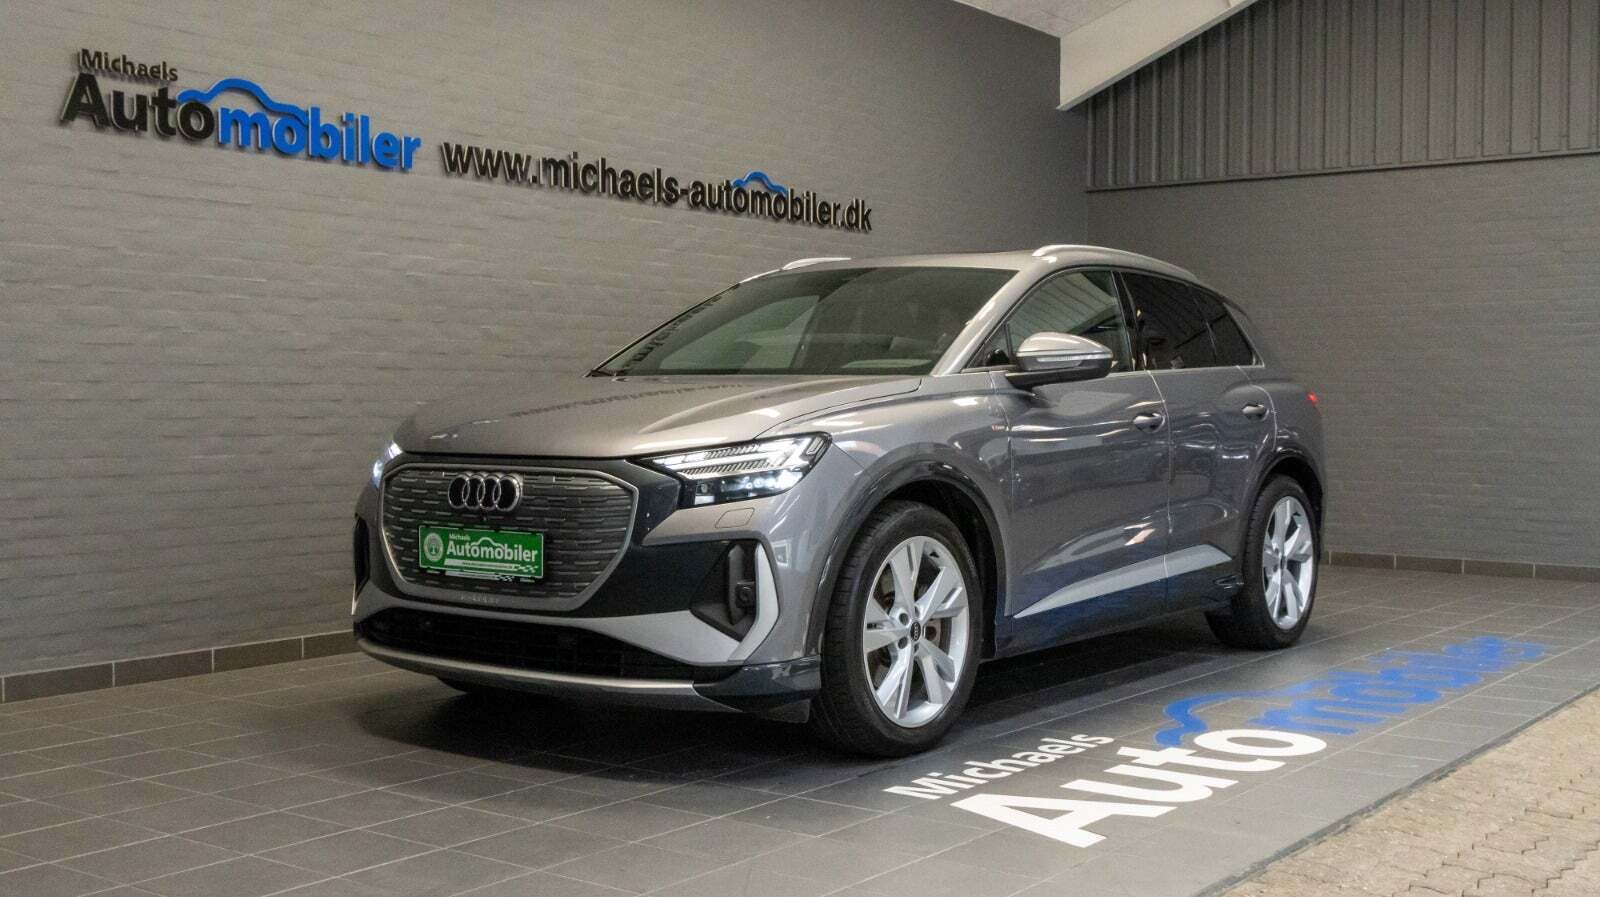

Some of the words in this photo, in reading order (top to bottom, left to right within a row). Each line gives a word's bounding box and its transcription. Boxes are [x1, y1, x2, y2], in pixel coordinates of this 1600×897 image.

[79, 48, 178, 82] Michaels
[60, 73, 421, 171] Automobiler
[440, 142, 872, 232] www.michaels-automobiler.dk
[446, 541, 538, 562] Automobiler
[885, 729, 1114, 801] Michaels
